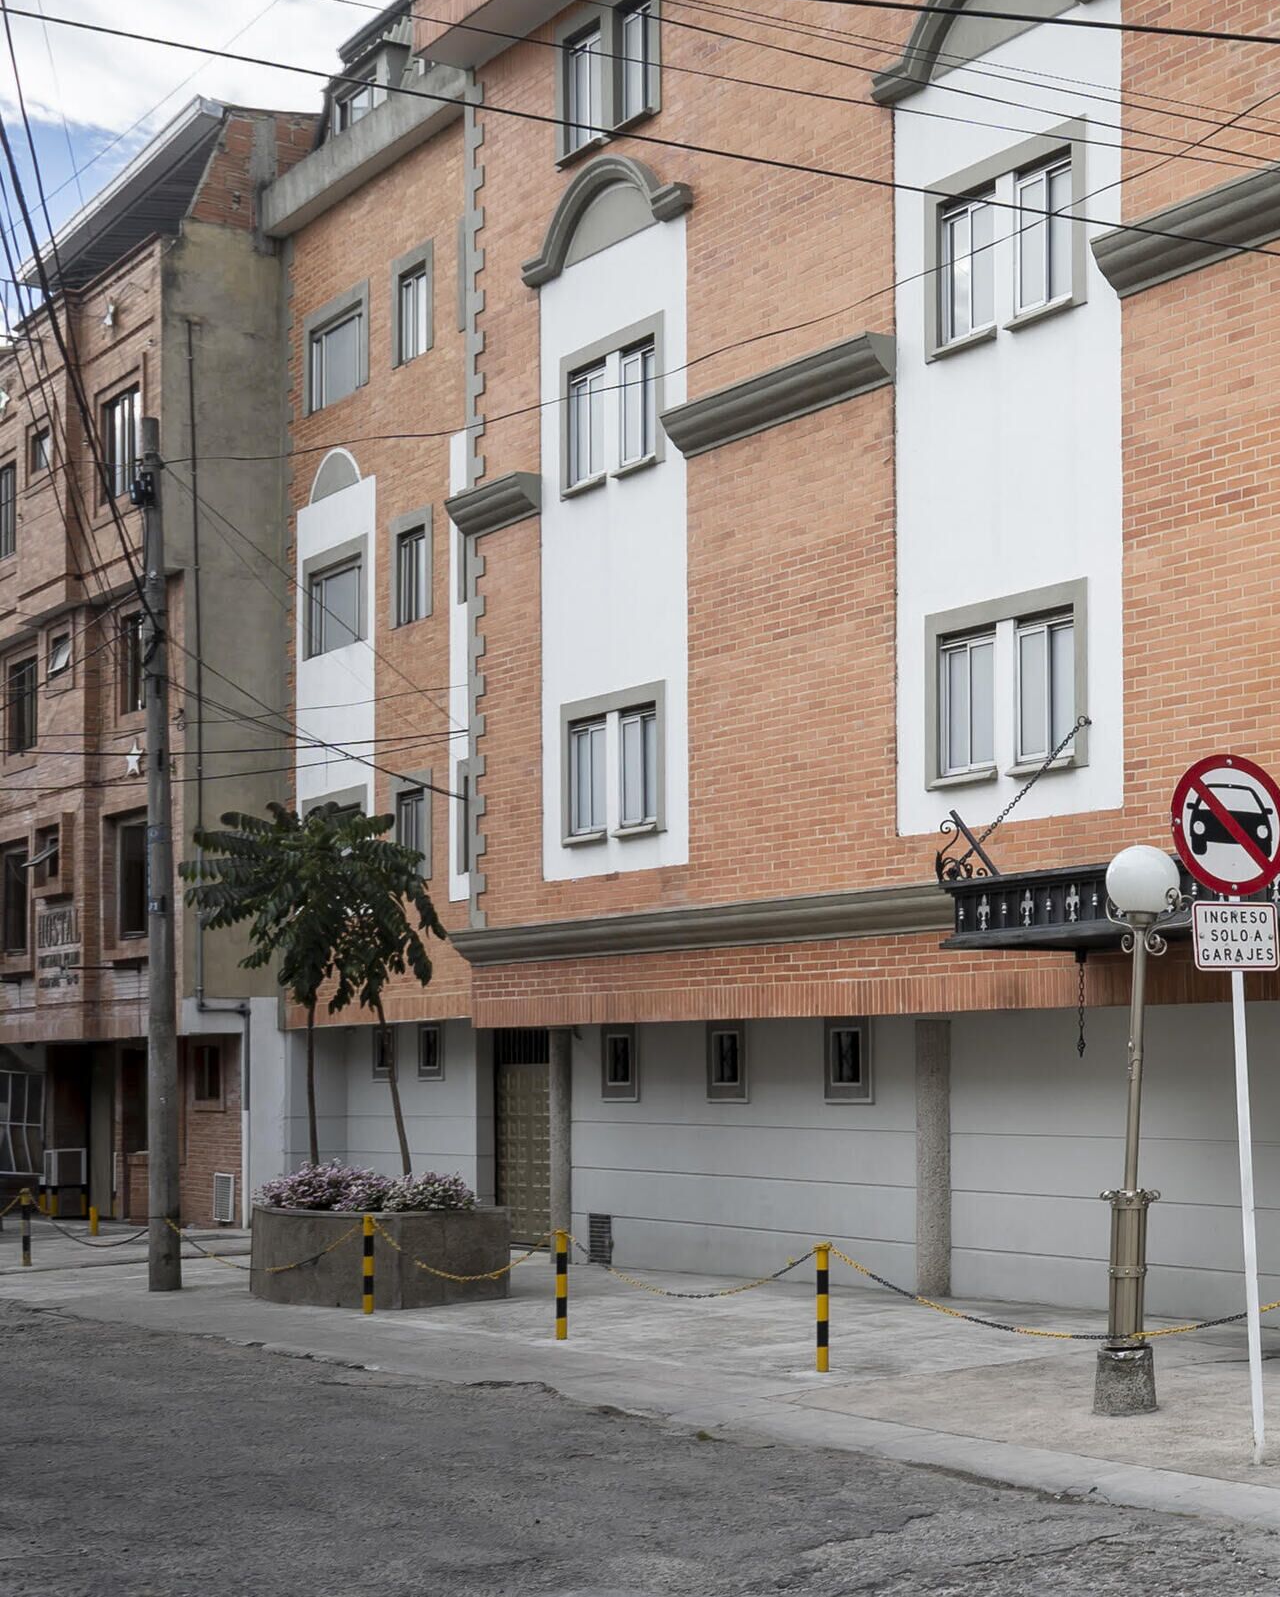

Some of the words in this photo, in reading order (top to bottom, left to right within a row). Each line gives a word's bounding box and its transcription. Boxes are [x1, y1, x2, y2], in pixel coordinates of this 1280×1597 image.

[1204, 911, 1268, 924] INGRESO
[38, 907, 81, 948] HOSTAL
[1211, 929, 1249, 942] SOLO
[1254, 930, 1262, 942] A
[1202, 948, 1274, 962] GARAJES
